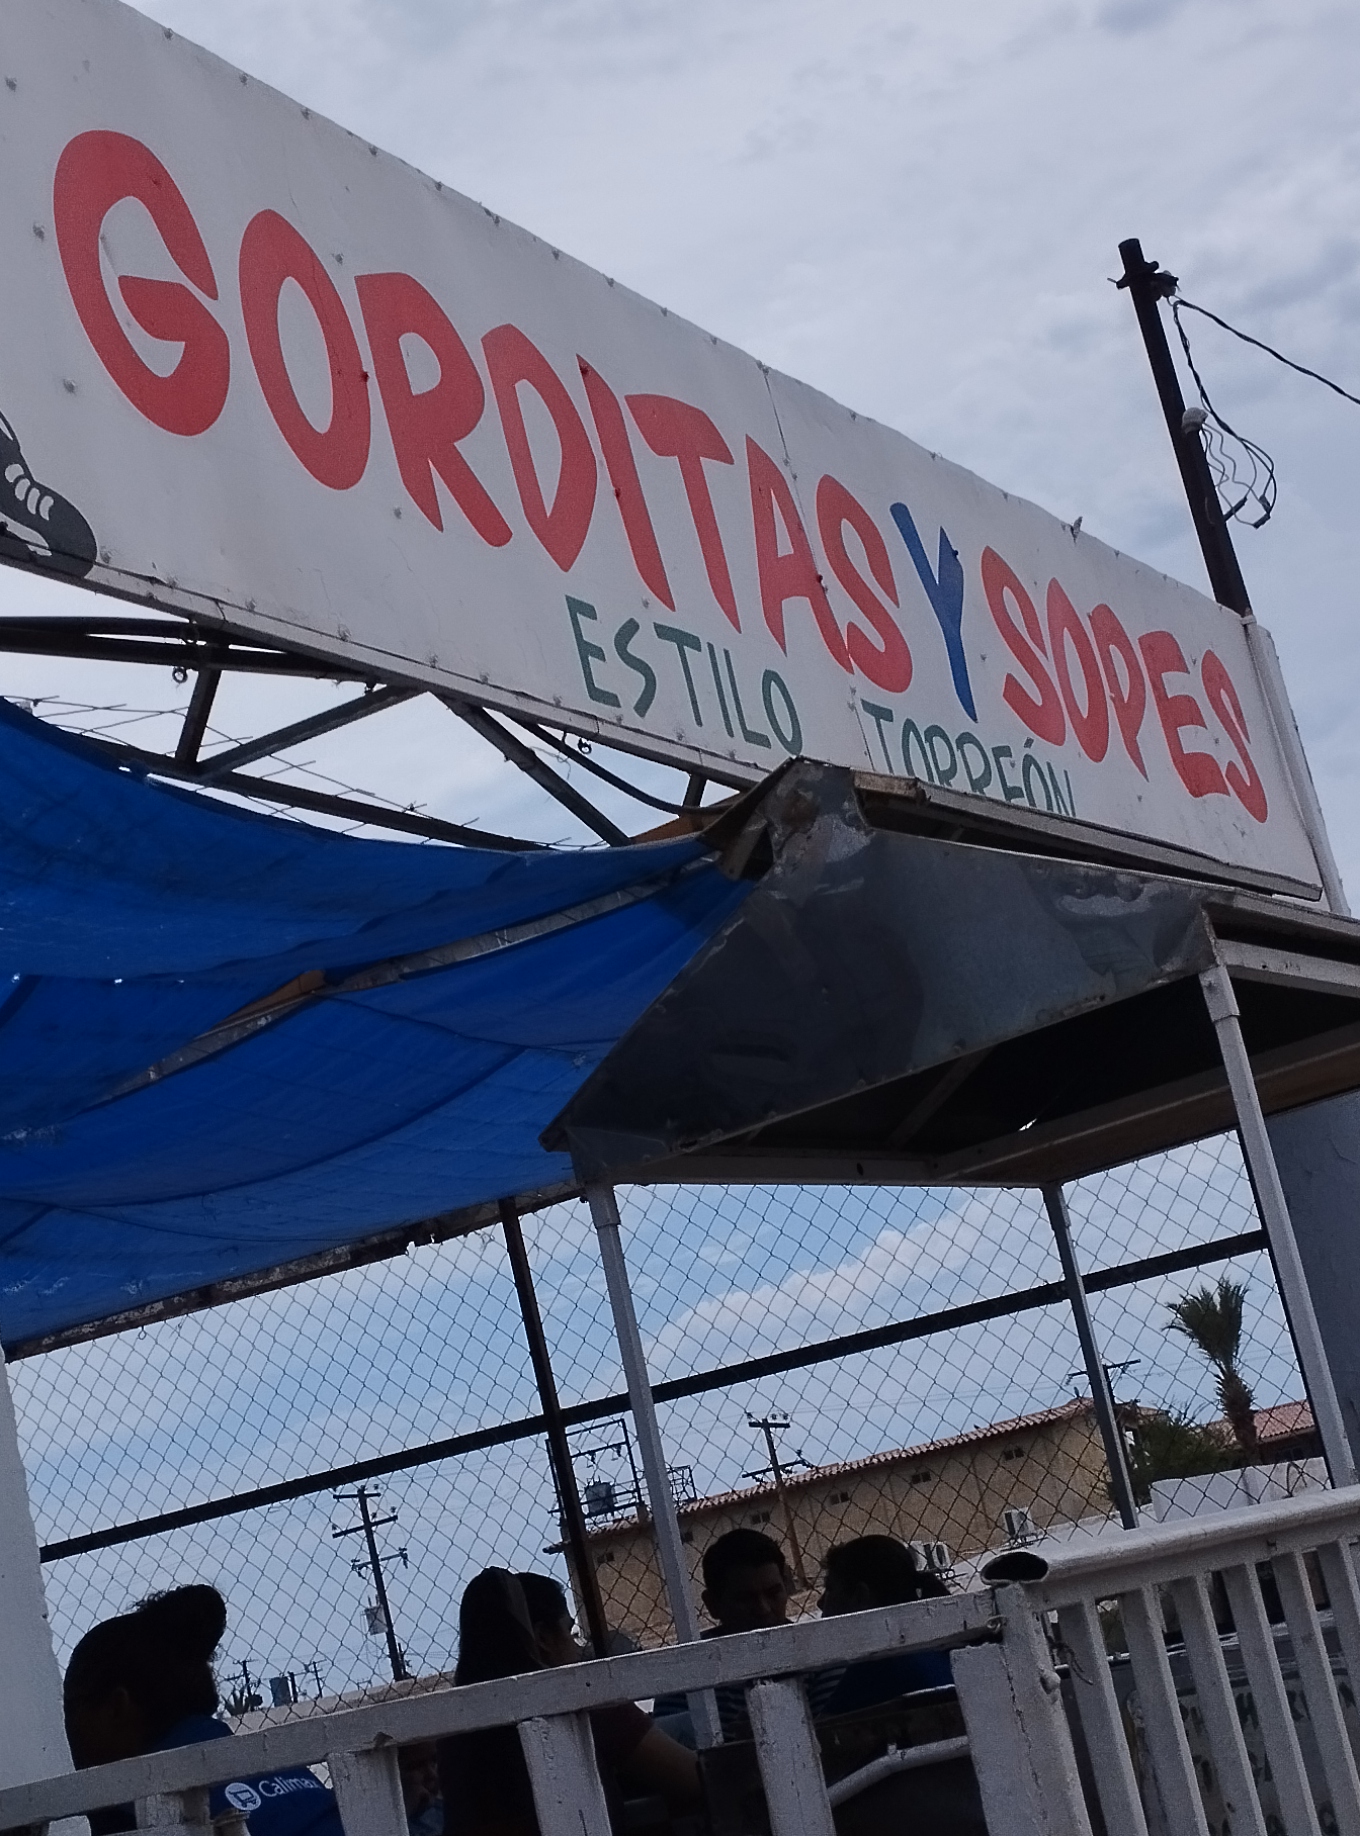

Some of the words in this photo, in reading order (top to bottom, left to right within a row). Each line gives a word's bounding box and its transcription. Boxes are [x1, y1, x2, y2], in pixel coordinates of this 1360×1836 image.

[52, 128, 913, 693] GORDITAS
[890, 502, 979, 723] Y
[981, 545, 1268, 823] SOPES
[565, 594, 805, 757] ESTILO
